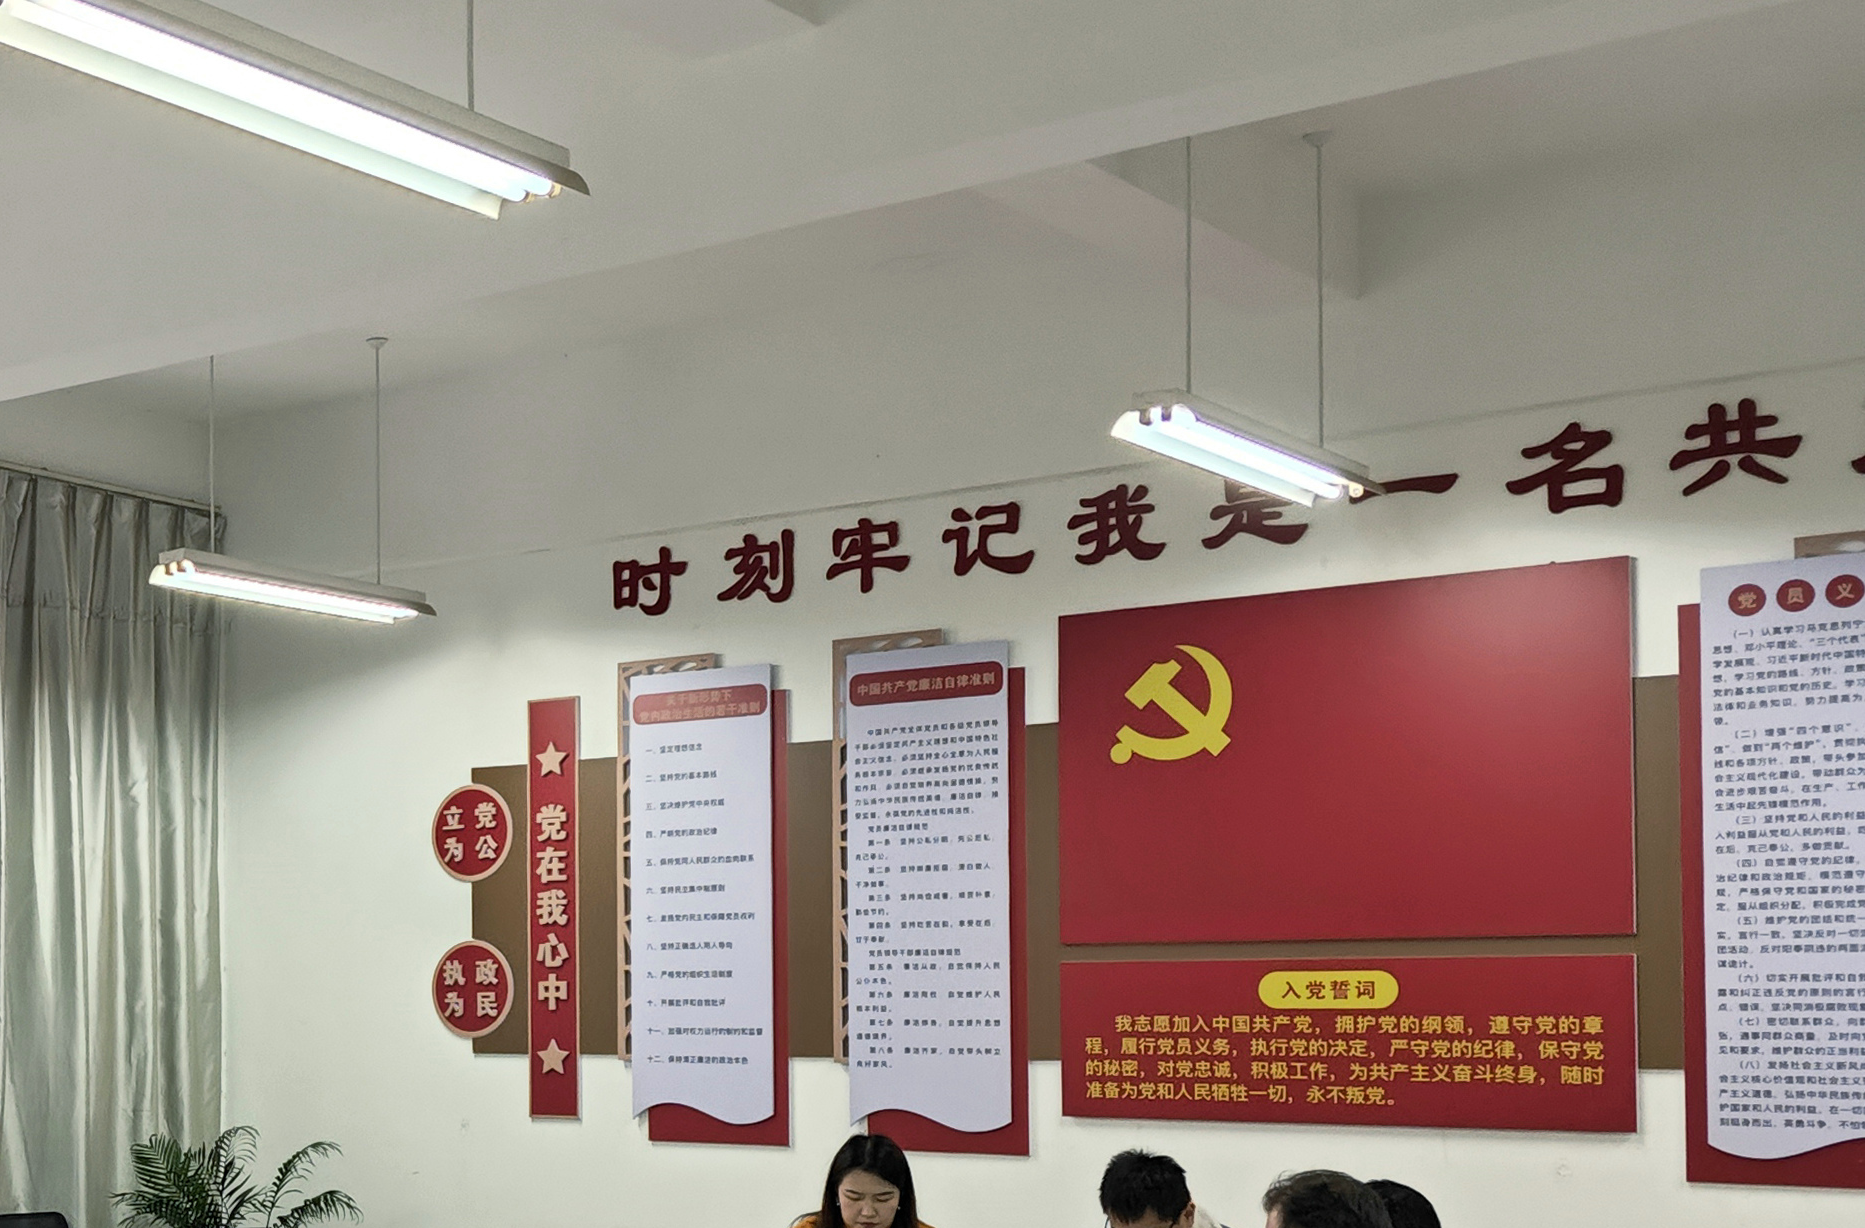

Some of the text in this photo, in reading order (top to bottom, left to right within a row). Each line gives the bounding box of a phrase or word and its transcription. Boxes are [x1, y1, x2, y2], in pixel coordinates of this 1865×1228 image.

[612, 398, 1865, 617] 时刻牢记我是一名共
[1737, 583, 1855, 609] 党员义
[857, 672, 995, 696] 中国共产党廉洁自律准则
[442, 802, 498, 832] 立党
[443, 834, 499, 863] 为公
[536, 804, 569, 1011] 党在我心中
[443, 959, 499, 987] 执政
[1281, 980, 1376, 1000] 入党誓词
[444, 991, 498, 1018] 为民
[1115, 1014, 1604, 1035] 我志愿加入中国共产党，拥护党的纲领，遵守党的章
[1085, 1037, 1605, 1060] 程，履行党员义务，执行党的决定，严守党的纪律，保守党
[1085, 1059, 1605, 1086] 的秘密，对党忠诚，积极工作，为共产主义奋斗终身，随时
[1719, 1074, 1865, 1086] 会主义核心价值观和社会主义
[1086, 1081, 1395, 1106] 准备为党和人民牺牲一切，永不叛党。
[1719, 1088, 1865, 1101] 产主义道德，弘扬中华民族传
[1719, 1102, 1865, 1116] 护国家和人民的利益，在一切
